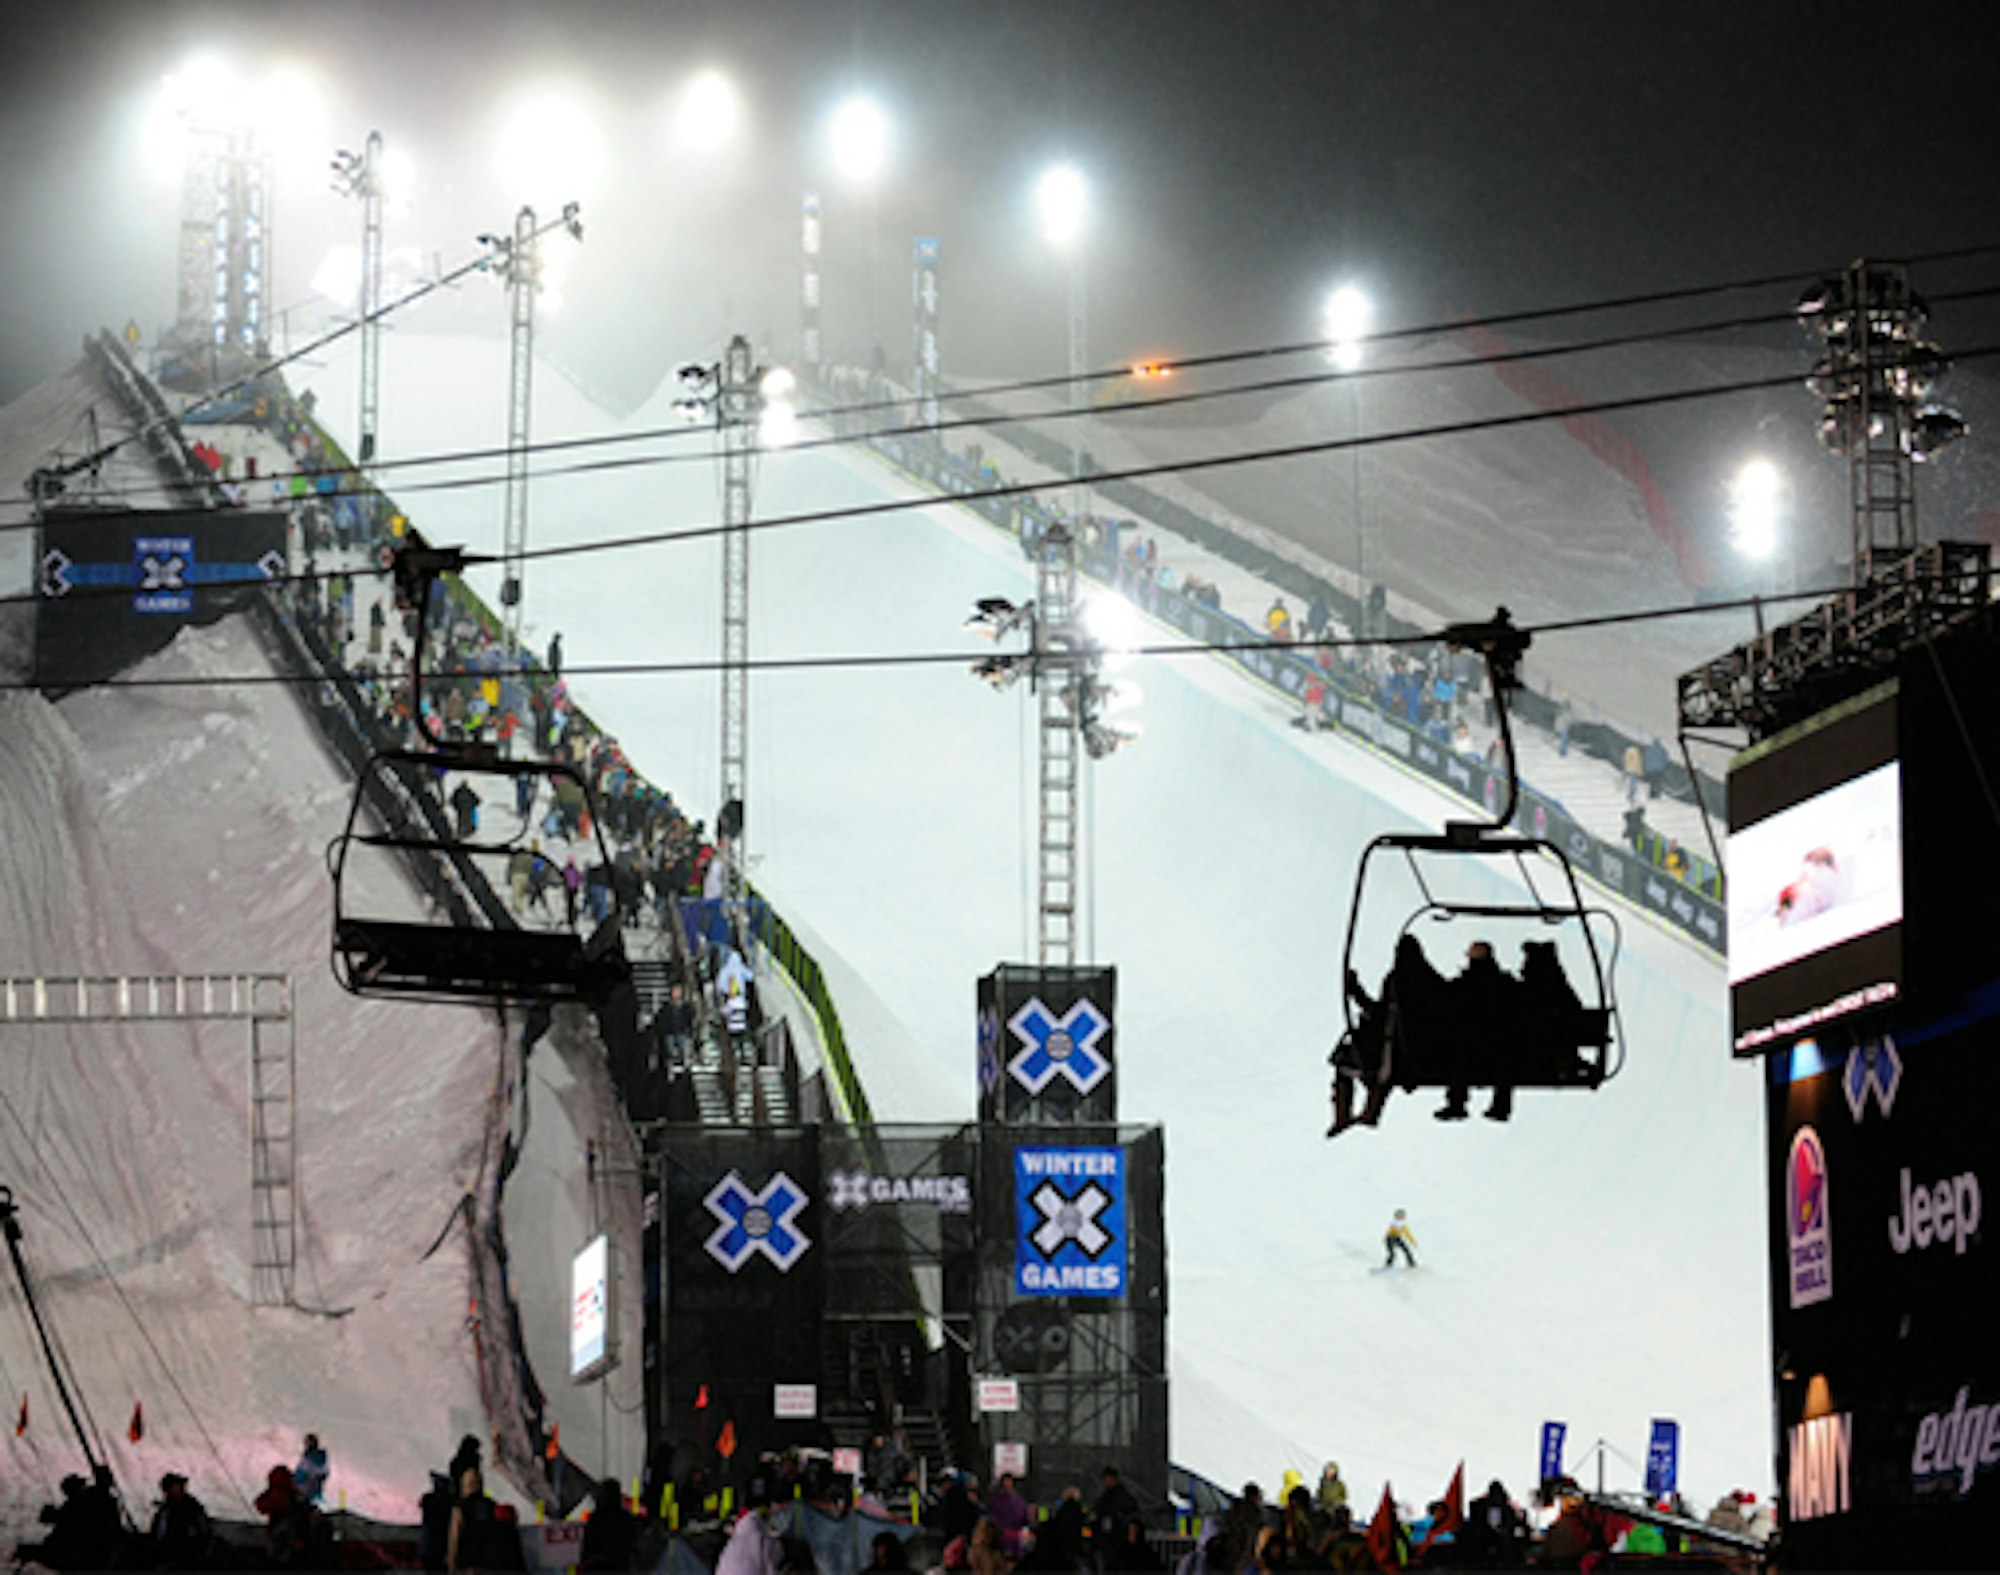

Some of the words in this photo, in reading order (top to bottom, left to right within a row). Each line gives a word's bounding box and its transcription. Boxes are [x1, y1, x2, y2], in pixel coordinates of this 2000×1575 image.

[871, 1175, 970, 1200] GAMES
[1021, 1152, 1117, 1175] WINTER
[1888, 1167, 1981, 1254] Jeep
[1021, 1263, 1120, 1290] GAMES
[1789, 1412, 1852, 1522] NAVY
[1911, 1385, 2000, 1494] edge
